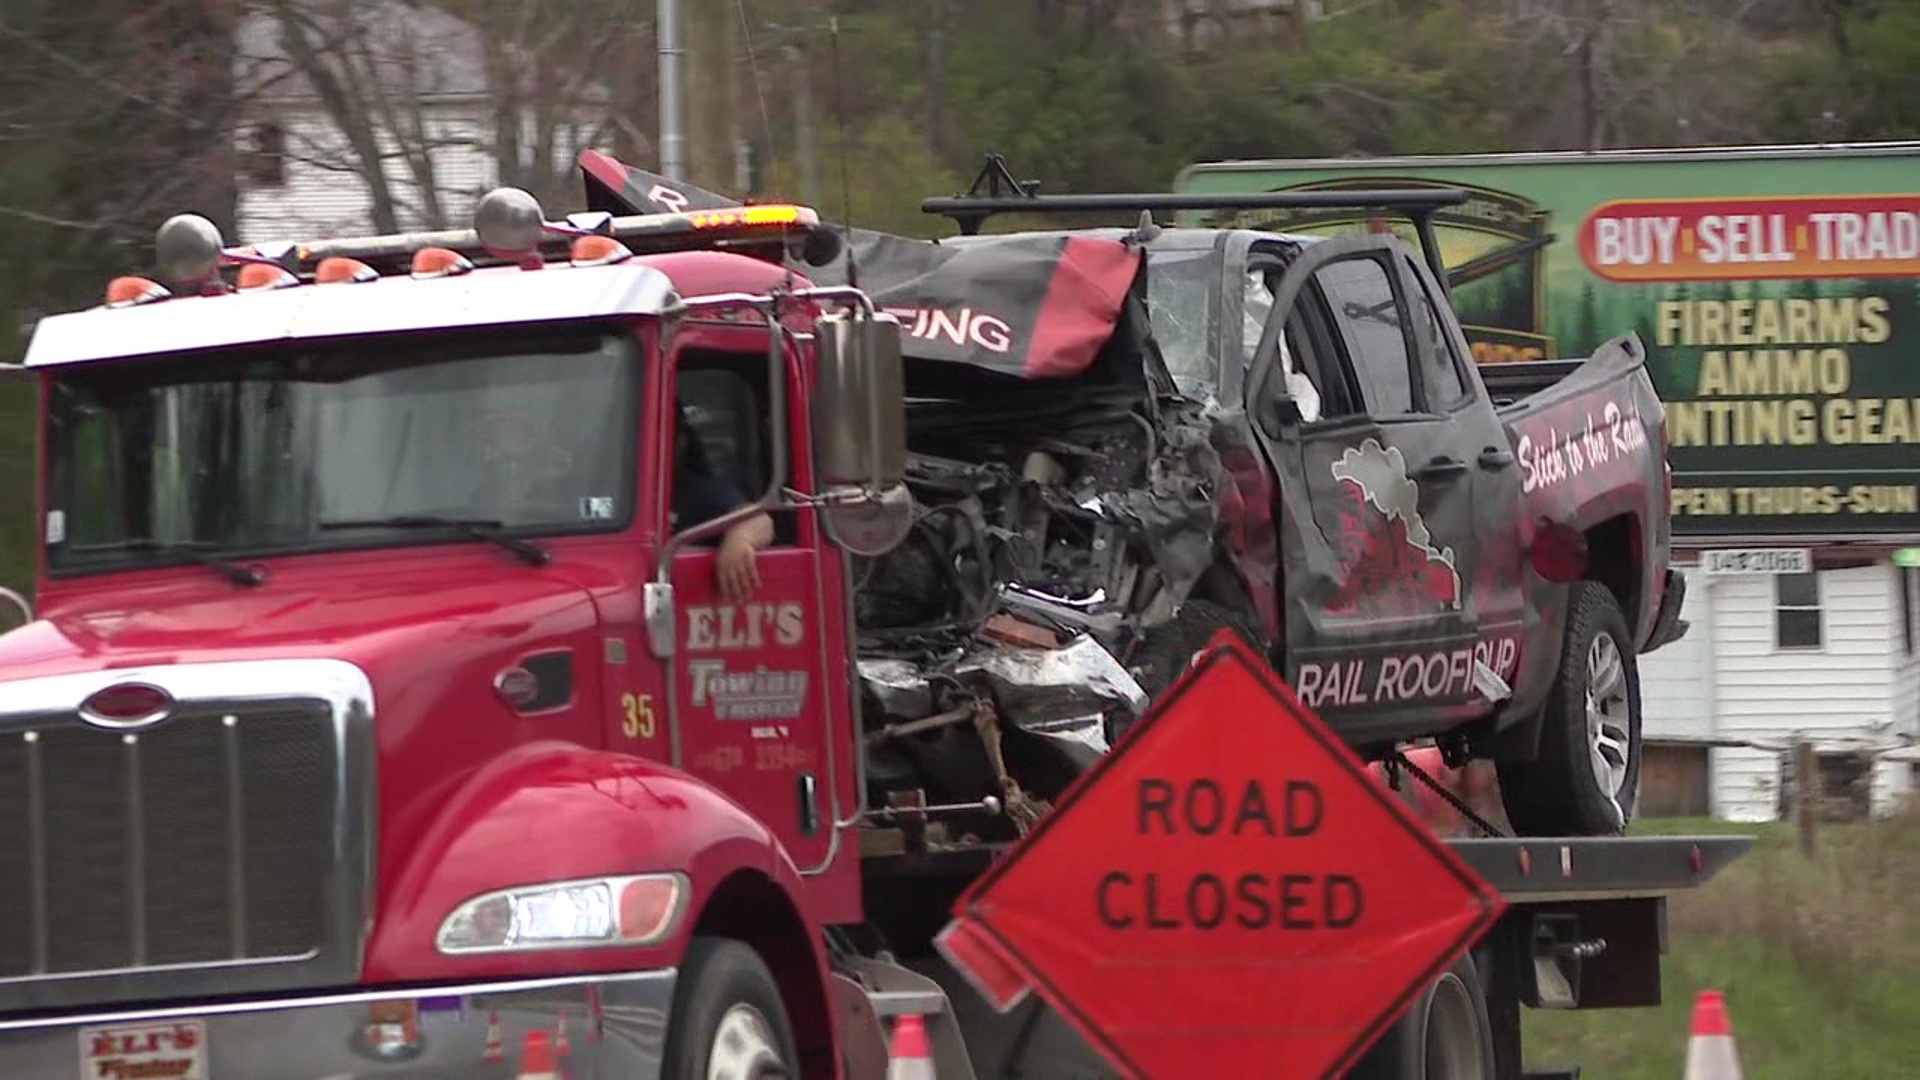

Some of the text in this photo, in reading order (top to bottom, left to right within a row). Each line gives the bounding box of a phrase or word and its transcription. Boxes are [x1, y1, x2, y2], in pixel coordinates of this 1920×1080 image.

[1595, 215, 1681, 265] BUY
[1697, 213, 1797, 263] SELL
[1657, 296, 1891, 346] FIREARMS
[1698, 348, 1850, 396] AMMO
[1518, 427, 1567, 493] Stick
[1565, 433, 1584, 476] to
[1583, 412, 1609, 468] the
[686, 603, 804, 649] ELI'S
[1297, 660, 1367, 707] RAIL
[621, 692, 657, 739] 35
[1136, 777, 1324, 837] ROAD
[1096, 870, 1364, 931] CLOSED
